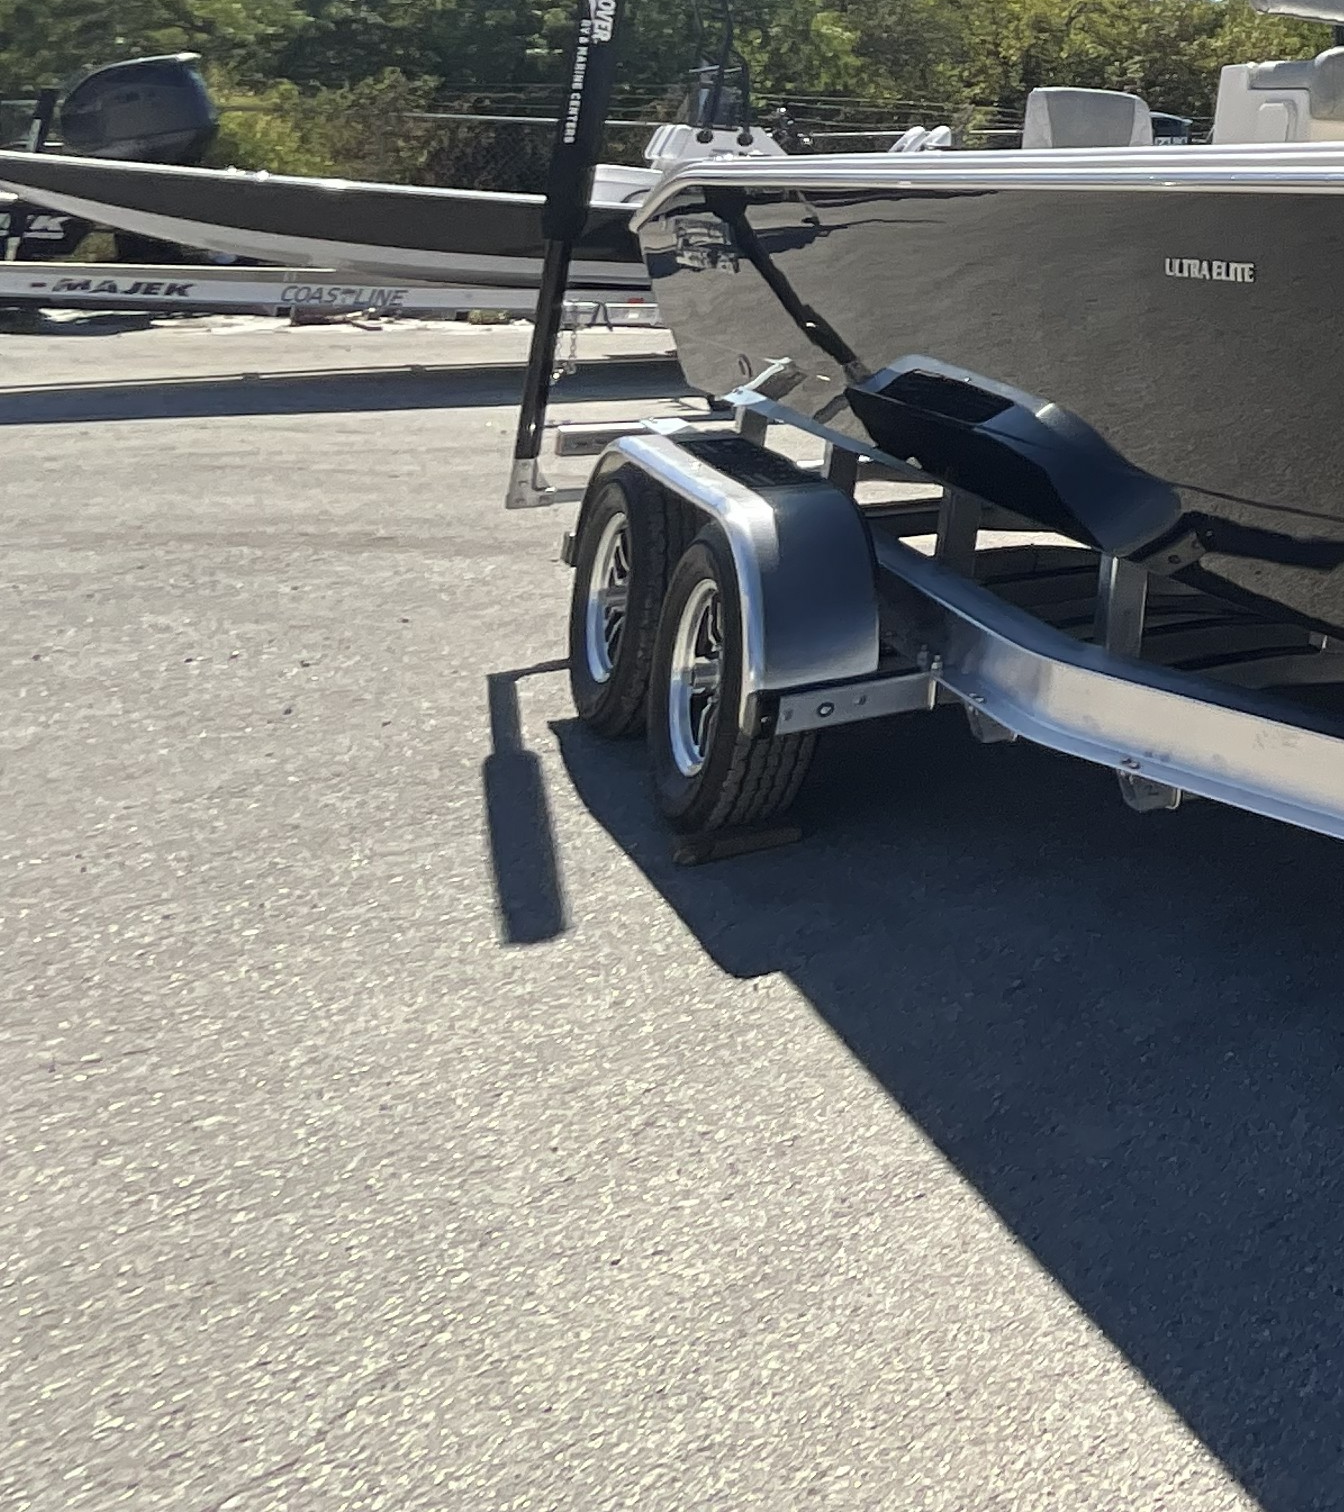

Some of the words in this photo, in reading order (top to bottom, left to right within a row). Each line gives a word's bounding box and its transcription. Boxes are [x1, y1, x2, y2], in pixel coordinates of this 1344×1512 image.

[1165, 258, 1210, 280] ULTRA
[1212, 260, 1255, 283] ELITE
[52, 278, 195, 297] MAJEK
